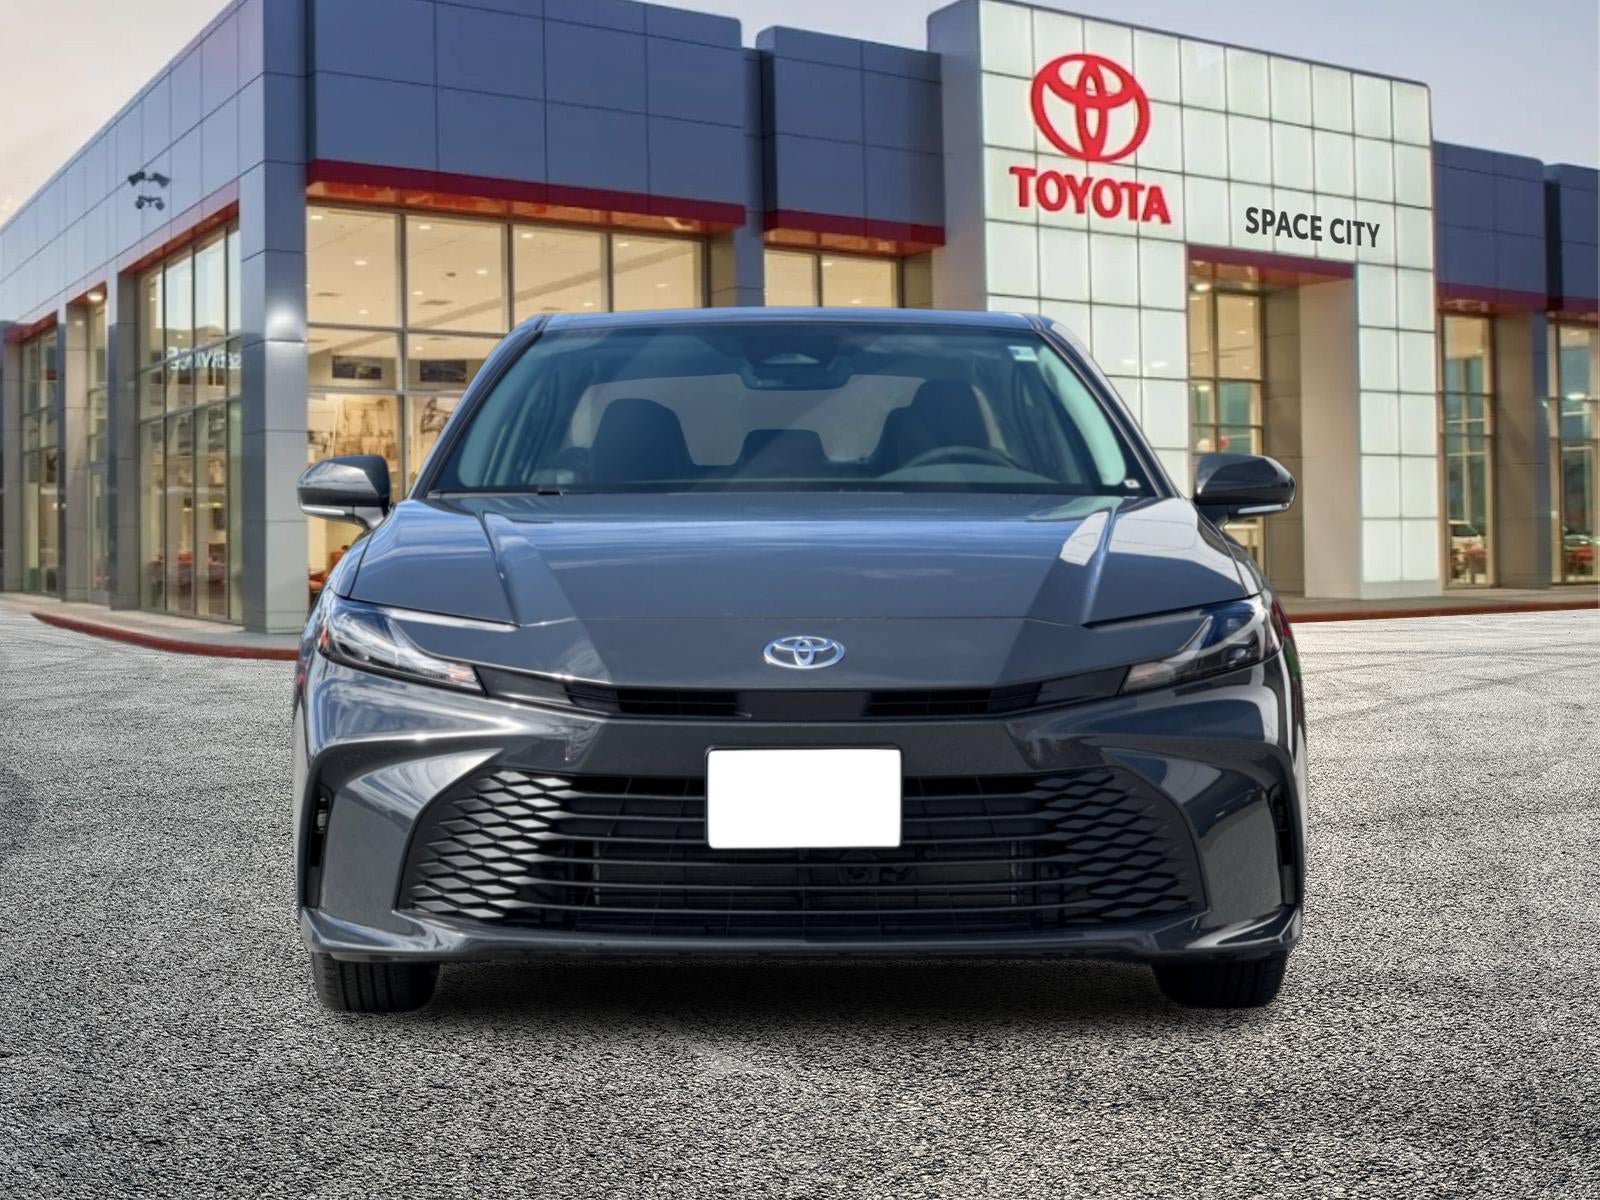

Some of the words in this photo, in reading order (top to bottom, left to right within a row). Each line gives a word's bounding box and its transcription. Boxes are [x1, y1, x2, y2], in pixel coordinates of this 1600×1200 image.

[1009, 166, 1171, 224] TOYOTA
[1245, 206, 1323, 241] SPACE
[1329, 217, 1380, 248] CITY
